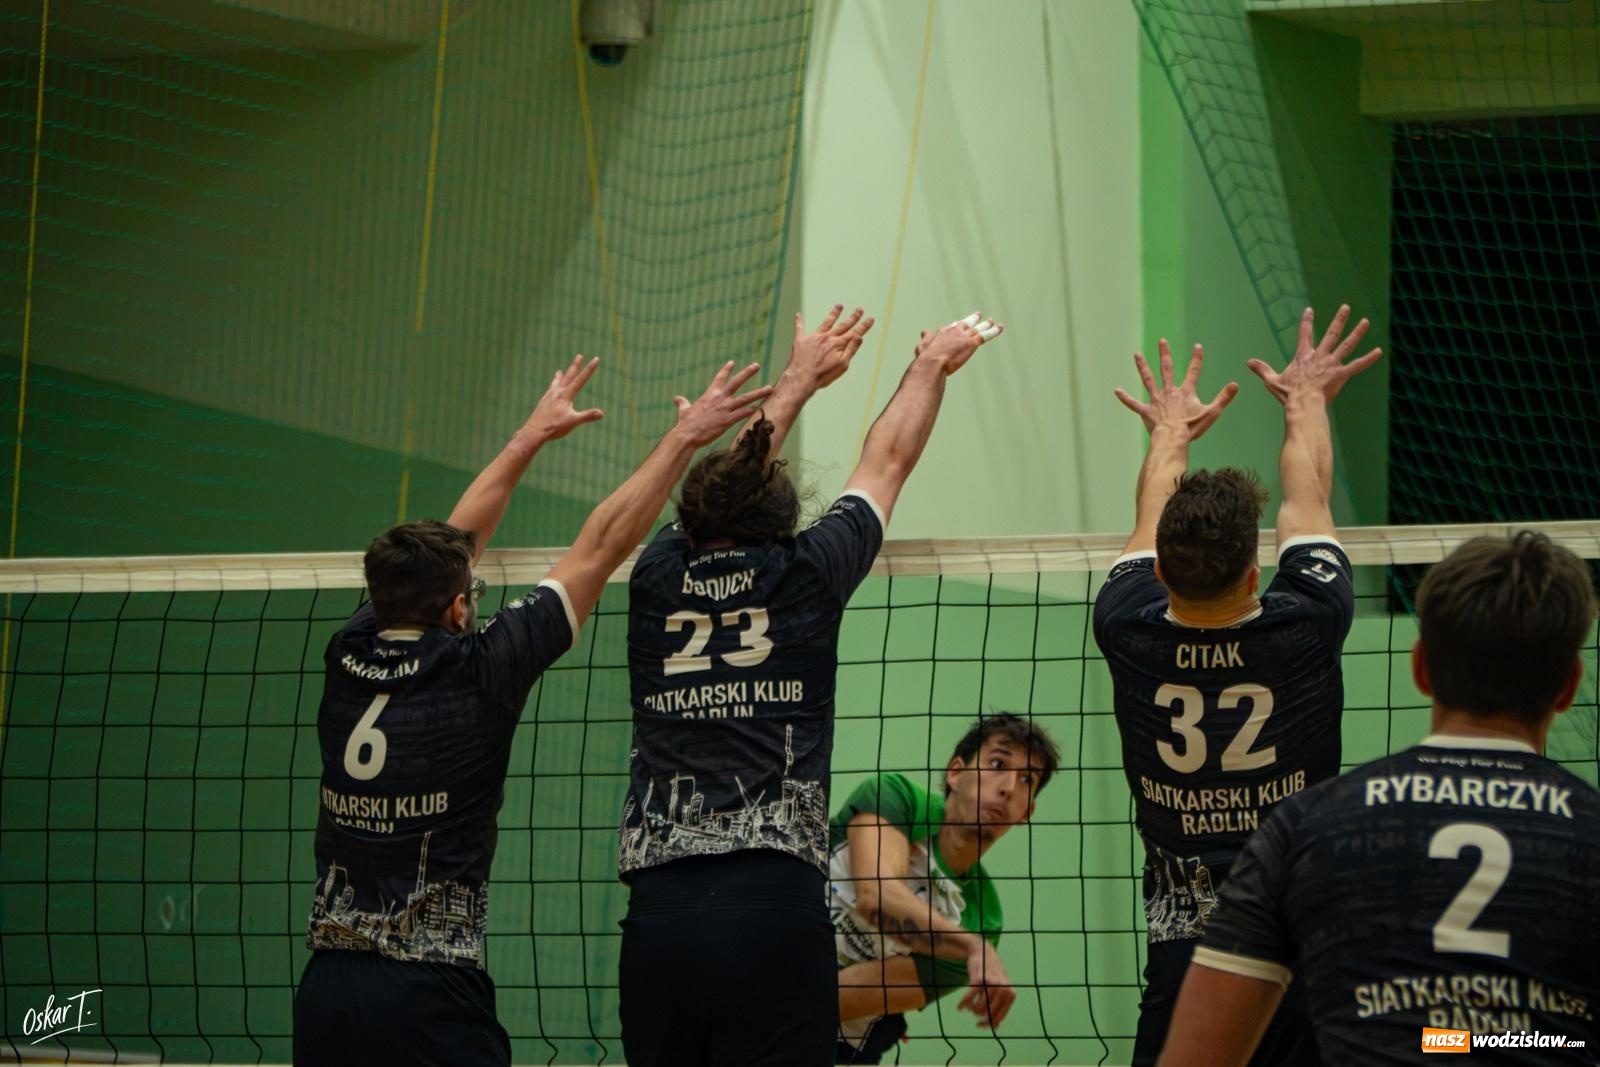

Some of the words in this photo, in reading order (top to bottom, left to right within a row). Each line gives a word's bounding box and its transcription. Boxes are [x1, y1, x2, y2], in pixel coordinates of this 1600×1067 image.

[663, 607, 775, 677] 23
[1175, 641, 1245, 669] CITAK
[753, 680, 804, 702] KLUB
[343, 693, 391, 781] 6
[1154, 682, 1277, 774] 32
[395, 791, 449, 820] KLUB
[1140, 776, 1250, 812] SIATKARSKI
[1257, 770, 1306, 808] KLUB
[1364, 774, 1574, 819] RYBARCZYK
[1181, 809, 1259, 836] RADLIN
[1428, 823, 1513, 959] 2
[1355, 975, 1520, 1019] SIATKARSKI
